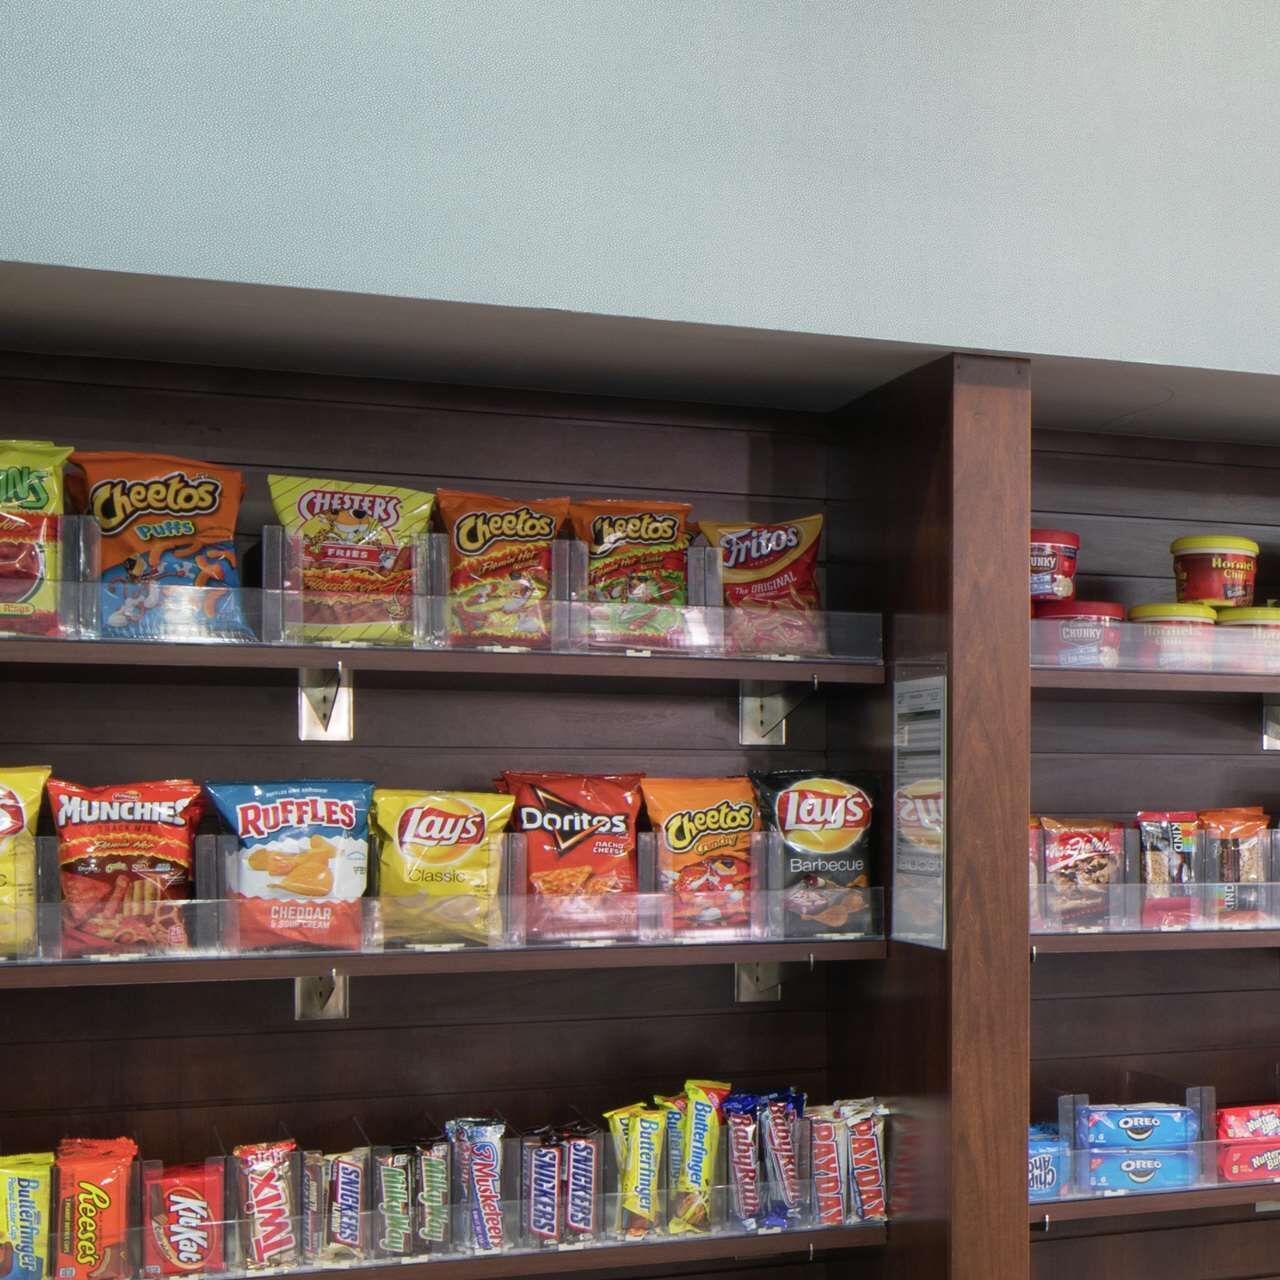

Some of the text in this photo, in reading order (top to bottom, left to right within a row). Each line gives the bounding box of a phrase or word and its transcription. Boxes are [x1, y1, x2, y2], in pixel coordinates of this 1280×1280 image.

[92, 475, 220, 530] Cheetos
[299, 490, 400, 528] CHESTER'S
[136, 520, 195, 540] Puffs
[458, 508, 551, 551] Cheetos
[723, 526, 799, 567] Fritos
[327, 548, 369, 559] FRIES
[1211, 557, 1254, 571] Hormel
[751, 574, 797, 594] ORIGINAL
[1223, 569, 1247, 579] Chili
[1062, 626, 1103, 639] CHUNKY
[238, 797, 356, 839] RUFFLES
[402, 807, 483, 846] Lay's
[520, 807, 627, 834] Doritos
[665, 803, 753, 853] Cheetos
[784, 789, 865, 829] Lay's
[592, 847, 625, 855] CHEESE
[595, 841, 625, 849] NACHO
[695, 835, 738, 854] Crunchy
[1172, 823, 1184, 853] KIND
[408, 868, 466, 882] Classic
[791, 857, 865, 873] Barbecue
[271, 906, 331, 921] CHEDDAR
[301, 920, 330, 928] CREAM
[729, 1112, 755, 1167] Baby
[1118, 1117, 1161, 1129] OREO
[687, 1100, 712, 1185] Butterfinger
[1252, 1149, 1280, 1169] Nutter
[634, 1118, 659, 1212] Butterfinger
[813, 1123, 844, 1225] PAYDAY
[851, 1119, 886, 1219] PAYDAY
[1120, 1159, 1162, 1171] OREO
[340, 1165, 360, 1245] SNICKERS
[472, 1143, 502, 1248] 3 Musketeers
[533, 1148, 557, 1236] SNICKERS
[569, 1142, 594, 1231] SNICKERS
[77, 1181, 110, 1267] Reese's
[249, 1168, 296, 1264] TWIX
